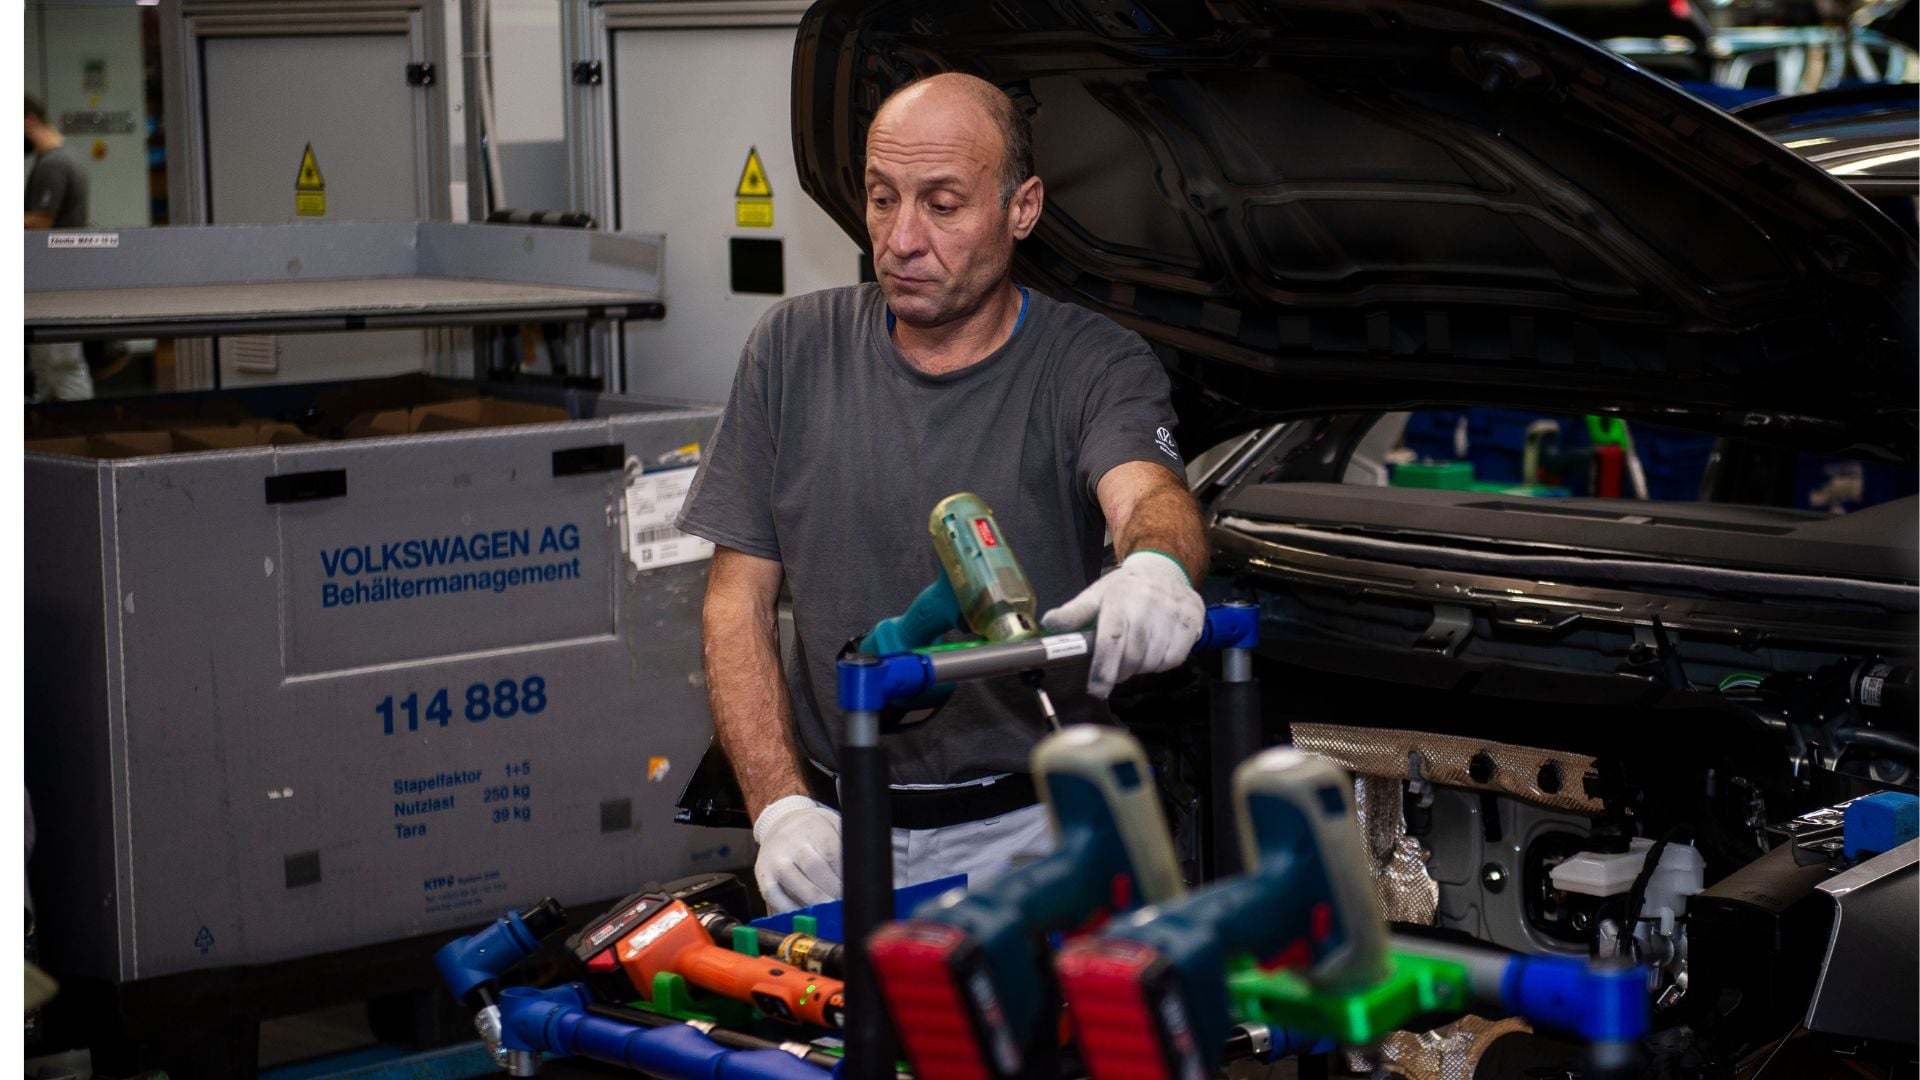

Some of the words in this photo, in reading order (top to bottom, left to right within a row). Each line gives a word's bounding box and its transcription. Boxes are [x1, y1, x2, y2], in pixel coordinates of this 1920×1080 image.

[320, 529, 530, 578] VOLKSWAGEN
[539, 523, 580, 555] AG
[322, 557, 581, 608] Behältermanagement
[376, 688, 452, 736] 114
[464, 675, 547, 723] 888
[394, 770, 482, 795] Stapelfaktor
[505, 761, 531, 777] 1+5
[394, 795, 455, 817] Nutzlast
[484, 786, 509, 803] 250
[513, 784, 531, 800] kg
[394, 822, 427, 839] Tara
[493, 808, 509, 824] 39
[513, 806, 531, 822] kg
